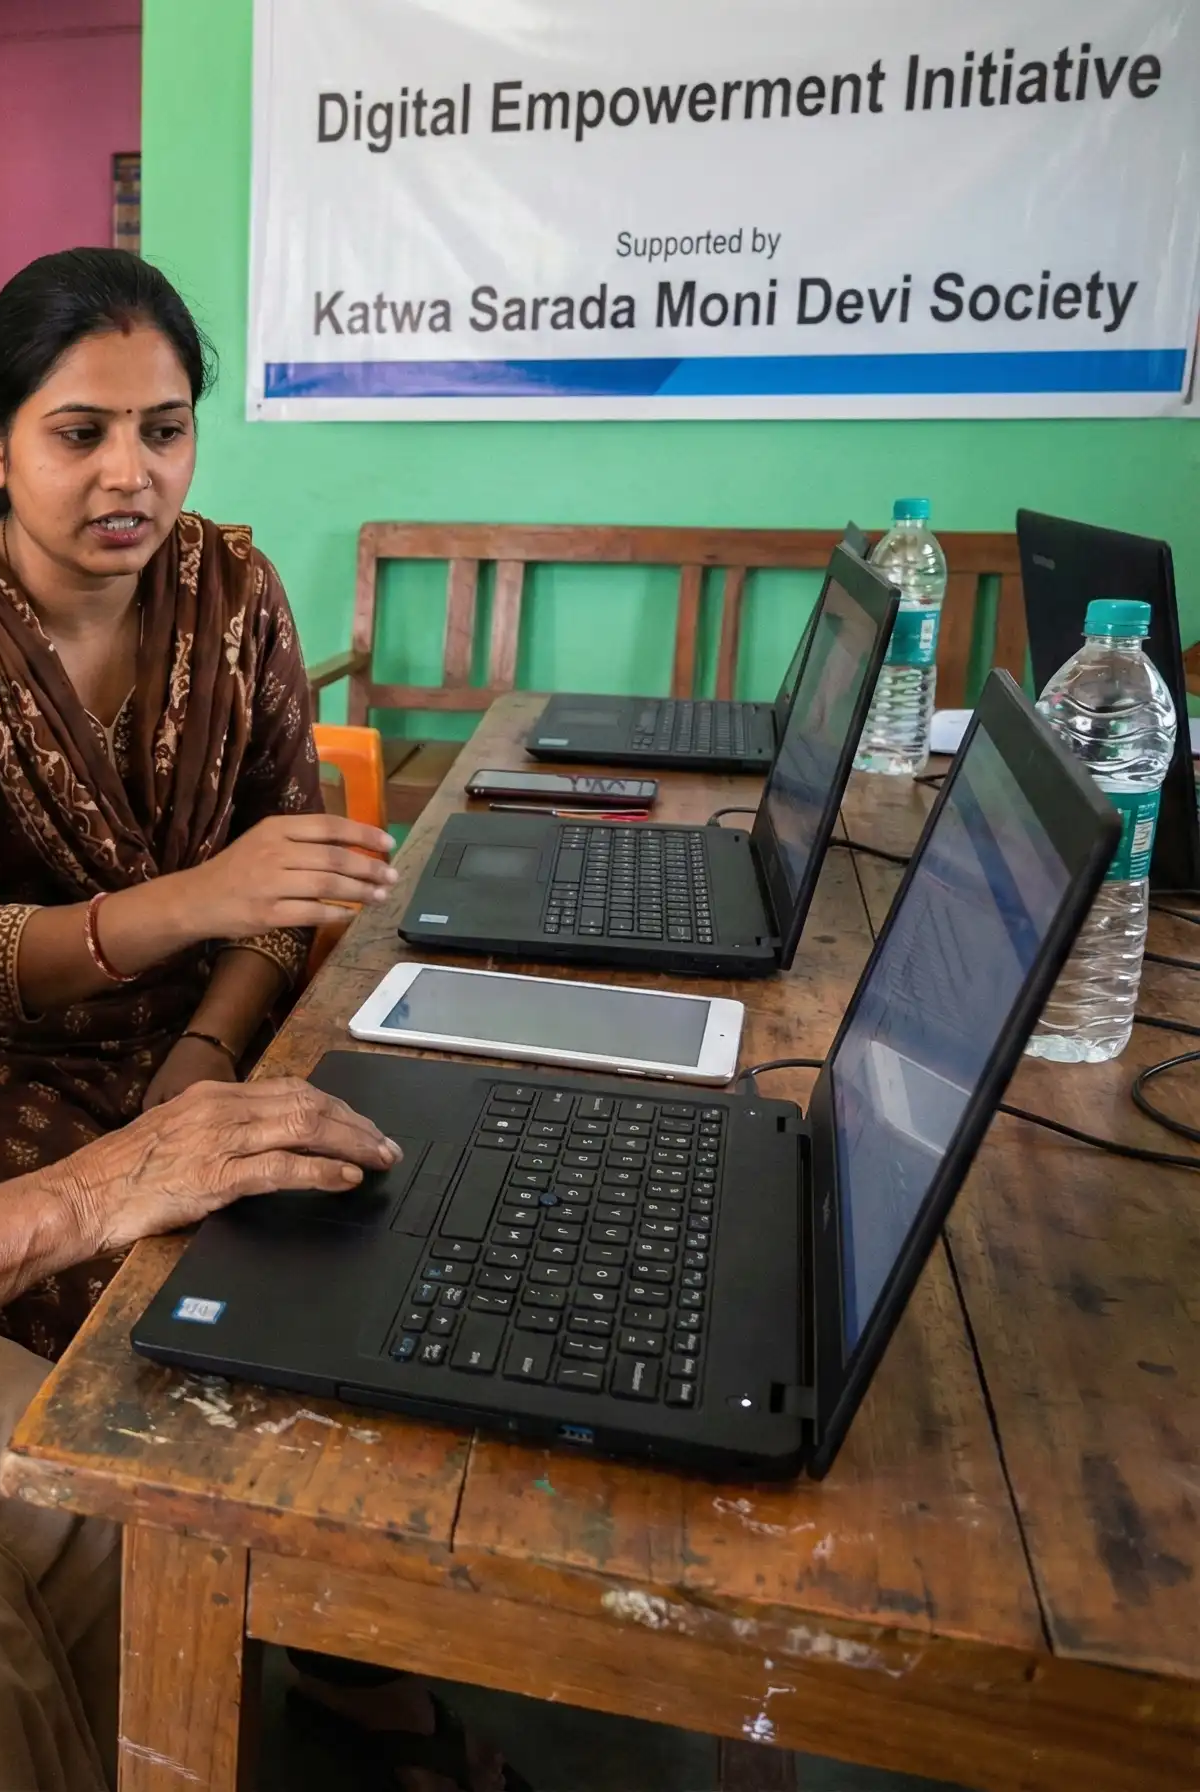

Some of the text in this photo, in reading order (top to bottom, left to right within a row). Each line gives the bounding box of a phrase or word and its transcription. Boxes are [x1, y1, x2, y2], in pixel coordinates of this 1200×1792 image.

[318, 42, 1163, 153] Digital Empowerment Initiative
[616, 228, 781, 262] Supported by
[315, 270, 1138, 335] Katwa Sarada Moni Devi Society
